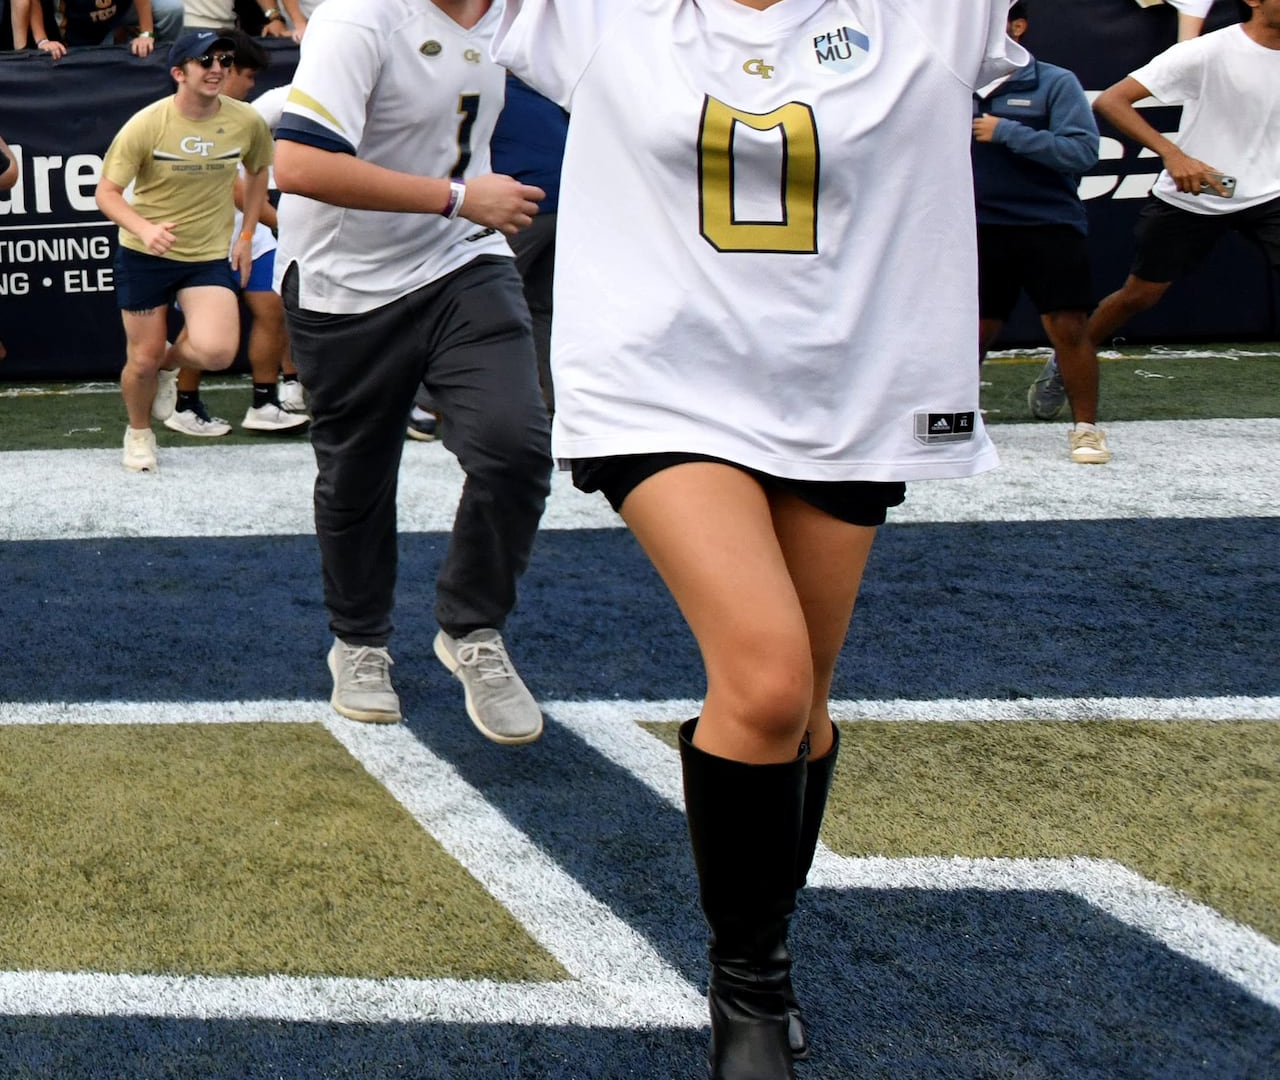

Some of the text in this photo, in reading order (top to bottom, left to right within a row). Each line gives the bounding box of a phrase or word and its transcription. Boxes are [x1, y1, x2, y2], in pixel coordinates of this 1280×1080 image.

[814, 26, 849, 49] PHI
[815, 42, 852, 65] MU
[180, 136, 214, 157] GT
[697, 93, 820, 255] 0
